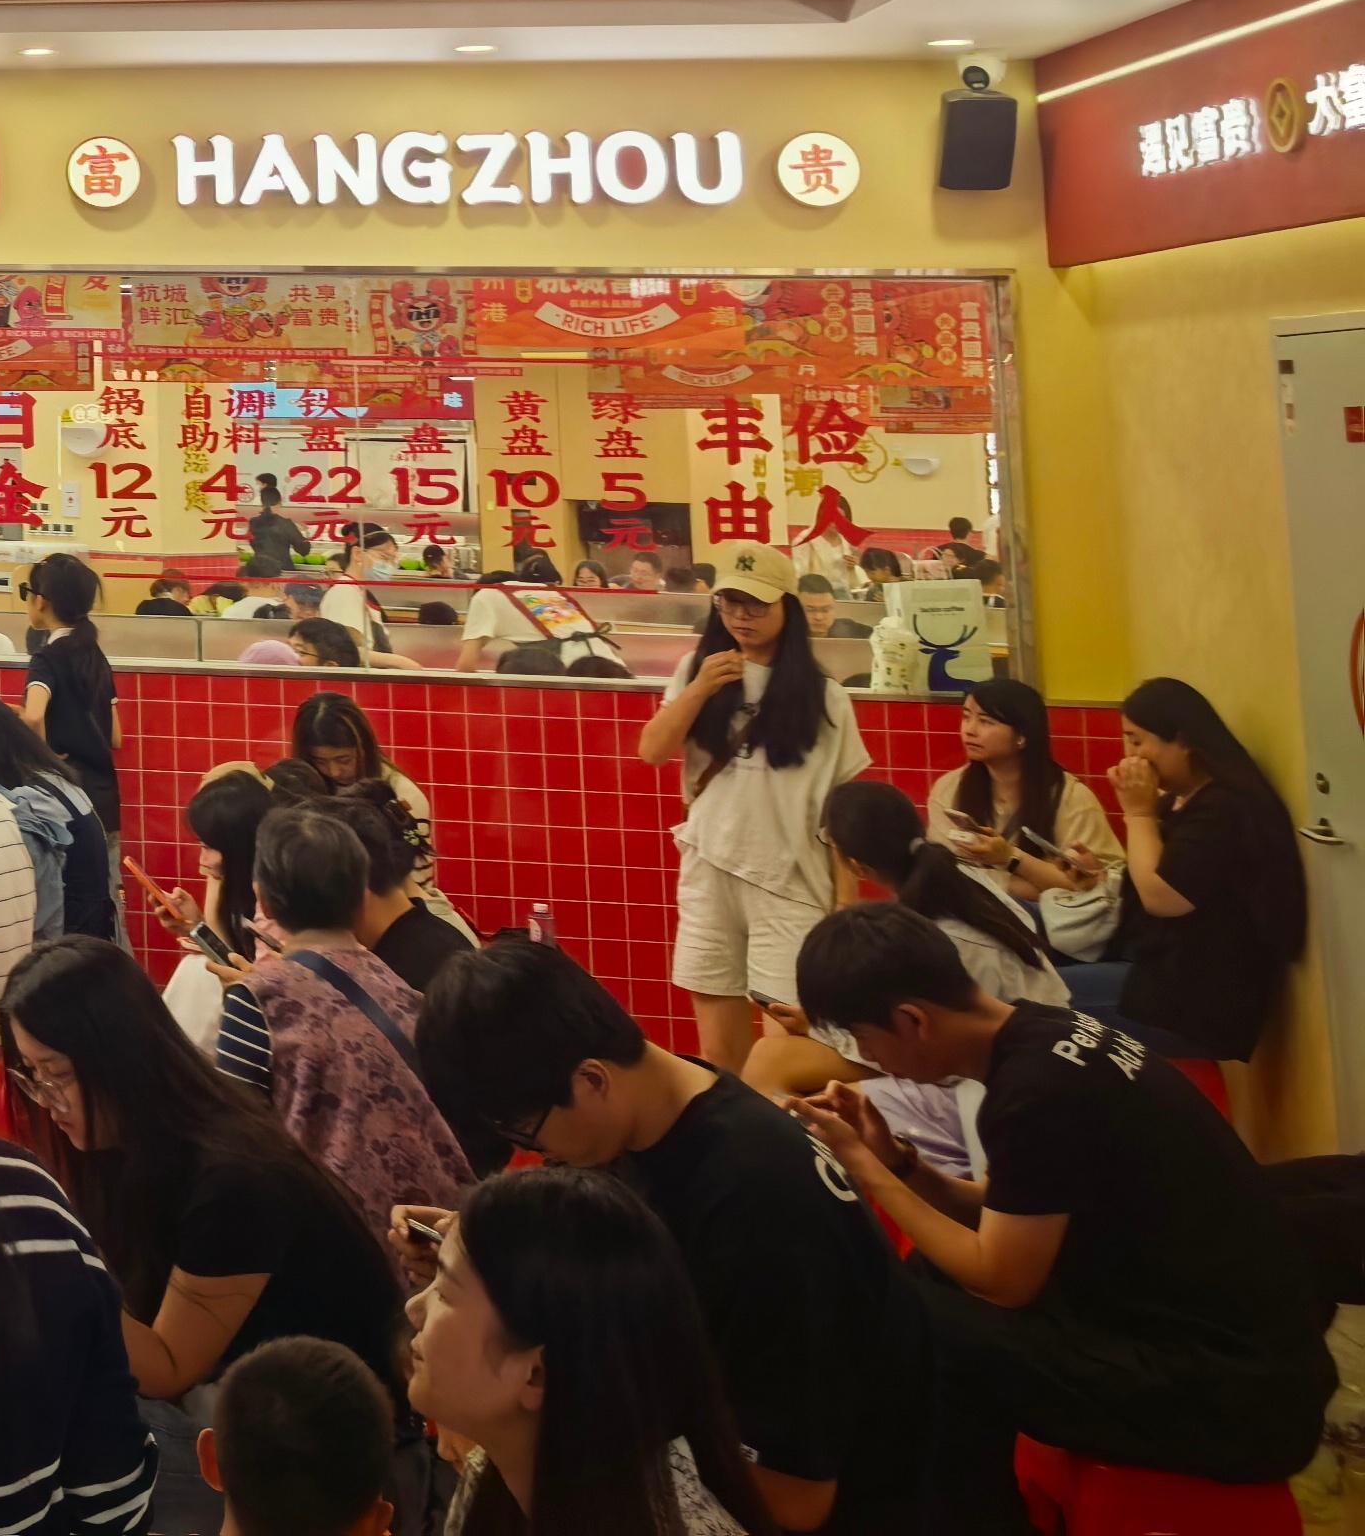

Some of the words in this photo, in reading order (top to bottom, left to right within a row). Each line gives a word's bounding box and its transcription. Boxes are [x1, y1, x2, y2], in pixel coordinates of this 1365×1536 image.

[76, 146, 127, 197] 富
[173, 131, 744, 206] HANGZHOU
[788, 144, 845, 195] 贵
[136, 283, 188, 304] 杭城
[288, 283, 336, 303] 共享
[63, 331, 84, 339] RICH
[291, 307, 339, 328] 富贵
[561, 316, 606, 336] RICH
[611, 316, 653, 335] LIFE
[96, 386, 147, 451] 锅底
[177, 388, 220, 454] 自助
[220, 387, 268, 455] 调料
[297, 388, 357, 452] 铁盘
[498, 390, 553, 456] 黄盘
[589, 393, 648, 459] 绿盘
[696, 396, 870, 466] 丰俭
[87, 462, 158, 500] 12
[199, 464, 249, 502] 4
[288, 465, 366, 504] 22
[389, 467, 460, 506] 15
[487, 469, 560, 508] 10
[600, 472, 648, 511] 5
[101, 507, 153, 538] 元
[201, 509, 255, 541] 元
[305, 511, 358, 543] 元
[404, 513, 457, 545] 元
[502, 515, 557, 548] 元
[703, 480, 874, 548] 由人
[600, 518, 658, 552] 元
